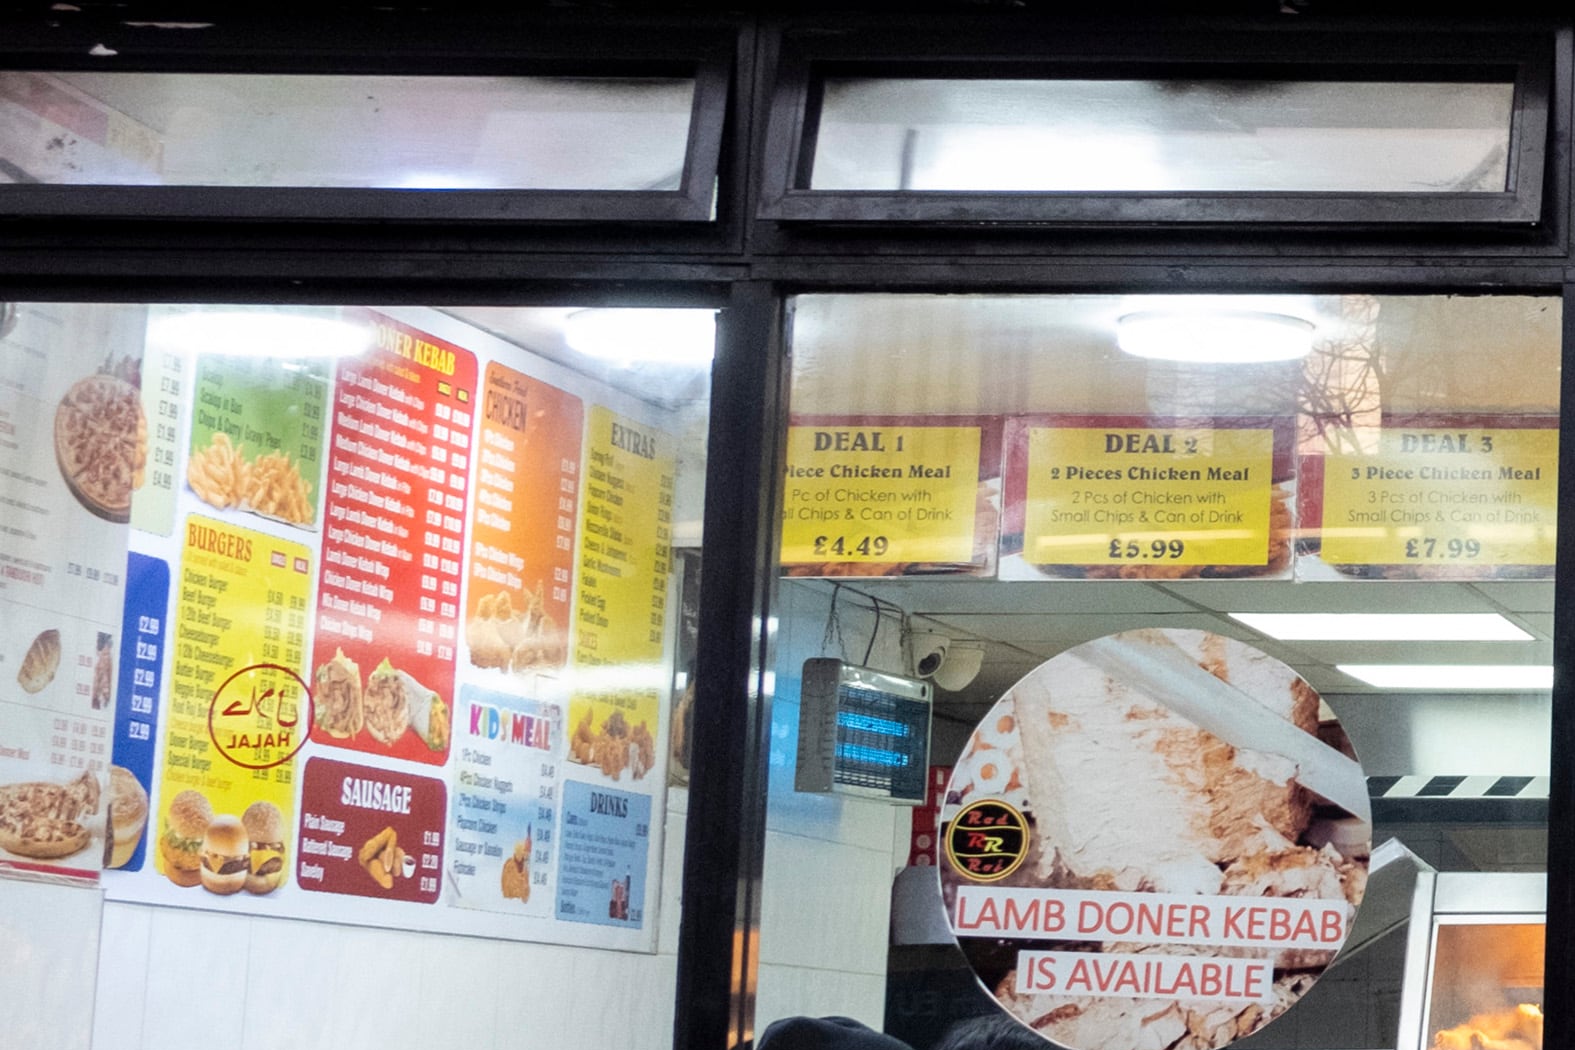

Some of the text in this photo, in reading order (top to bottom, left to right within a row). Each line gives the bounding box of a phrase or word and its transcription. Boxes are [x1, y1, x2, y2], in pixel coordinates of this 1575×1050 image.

[415, 339, 455, 376] KEBAB
[486, 390, 526, 432] CHICKEN
[612, 422, 655, 460] EXTRAS
[814, 432, 903, 451] DEAL 1
[1105, 434, 1198, 453] DEAL 2
[1400, 434, 1493, 453] DEAL 3
[830, 464, 902, 478] Chicken
[908, 465, 950, 478] Meal
[1051, 466, 1248, 480] 2 Pieces Chicken Meal
[1352, 466, 1540, 480] 3 Piece Chicken Meal
[816, 489, 829, 501] of
[835, 489, 896, 501] Chicken
[900, 489, 931, 501] with
[1072, 491, 1225, 504] 2 Pcs of Chicken with
[1051, 511, 1243, 524] Small Chips & Can of Drink
[188, 523, 252, 562] BURGERS
[814, 536, 888, 555] £4.49
[1109, 539, 1184, 558] £5.99
[1406, 538, 1481, 558] £7.99
[470, 704, 510, 742] KIDS
[512, 713, 550, 751] MEAL
[341, 777, 412, 814] SAUSAGE
[591, 792, 628, 818] DRINKS
[968, 810, 1008, 825] Rod
[958, 896, 1343, 943] LAMB DONER KEBAB
[1026, 956, 1264, 998] IS AVAILABLE
